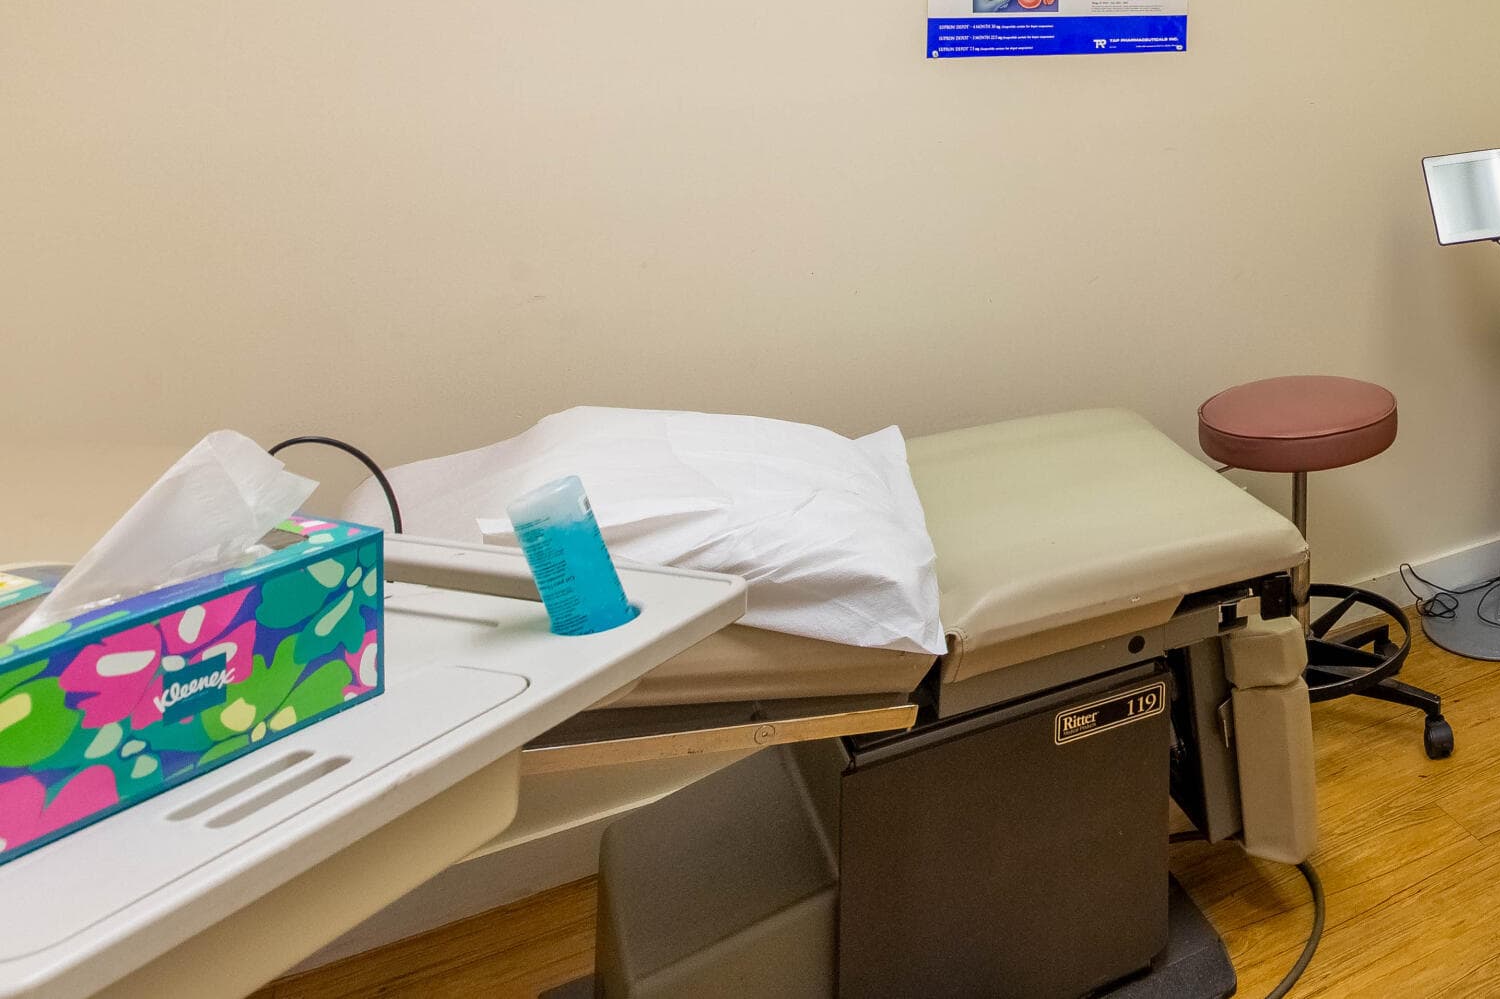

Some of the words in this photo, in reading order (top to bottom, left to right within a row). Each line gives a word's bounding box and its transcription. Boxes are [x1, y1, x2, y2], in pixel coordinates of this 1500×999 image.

[153, 667, 236, 714] Kleenex
[1127, 693, 1157, 716] 119
[1062, 711, 1098, 731] Ritter
